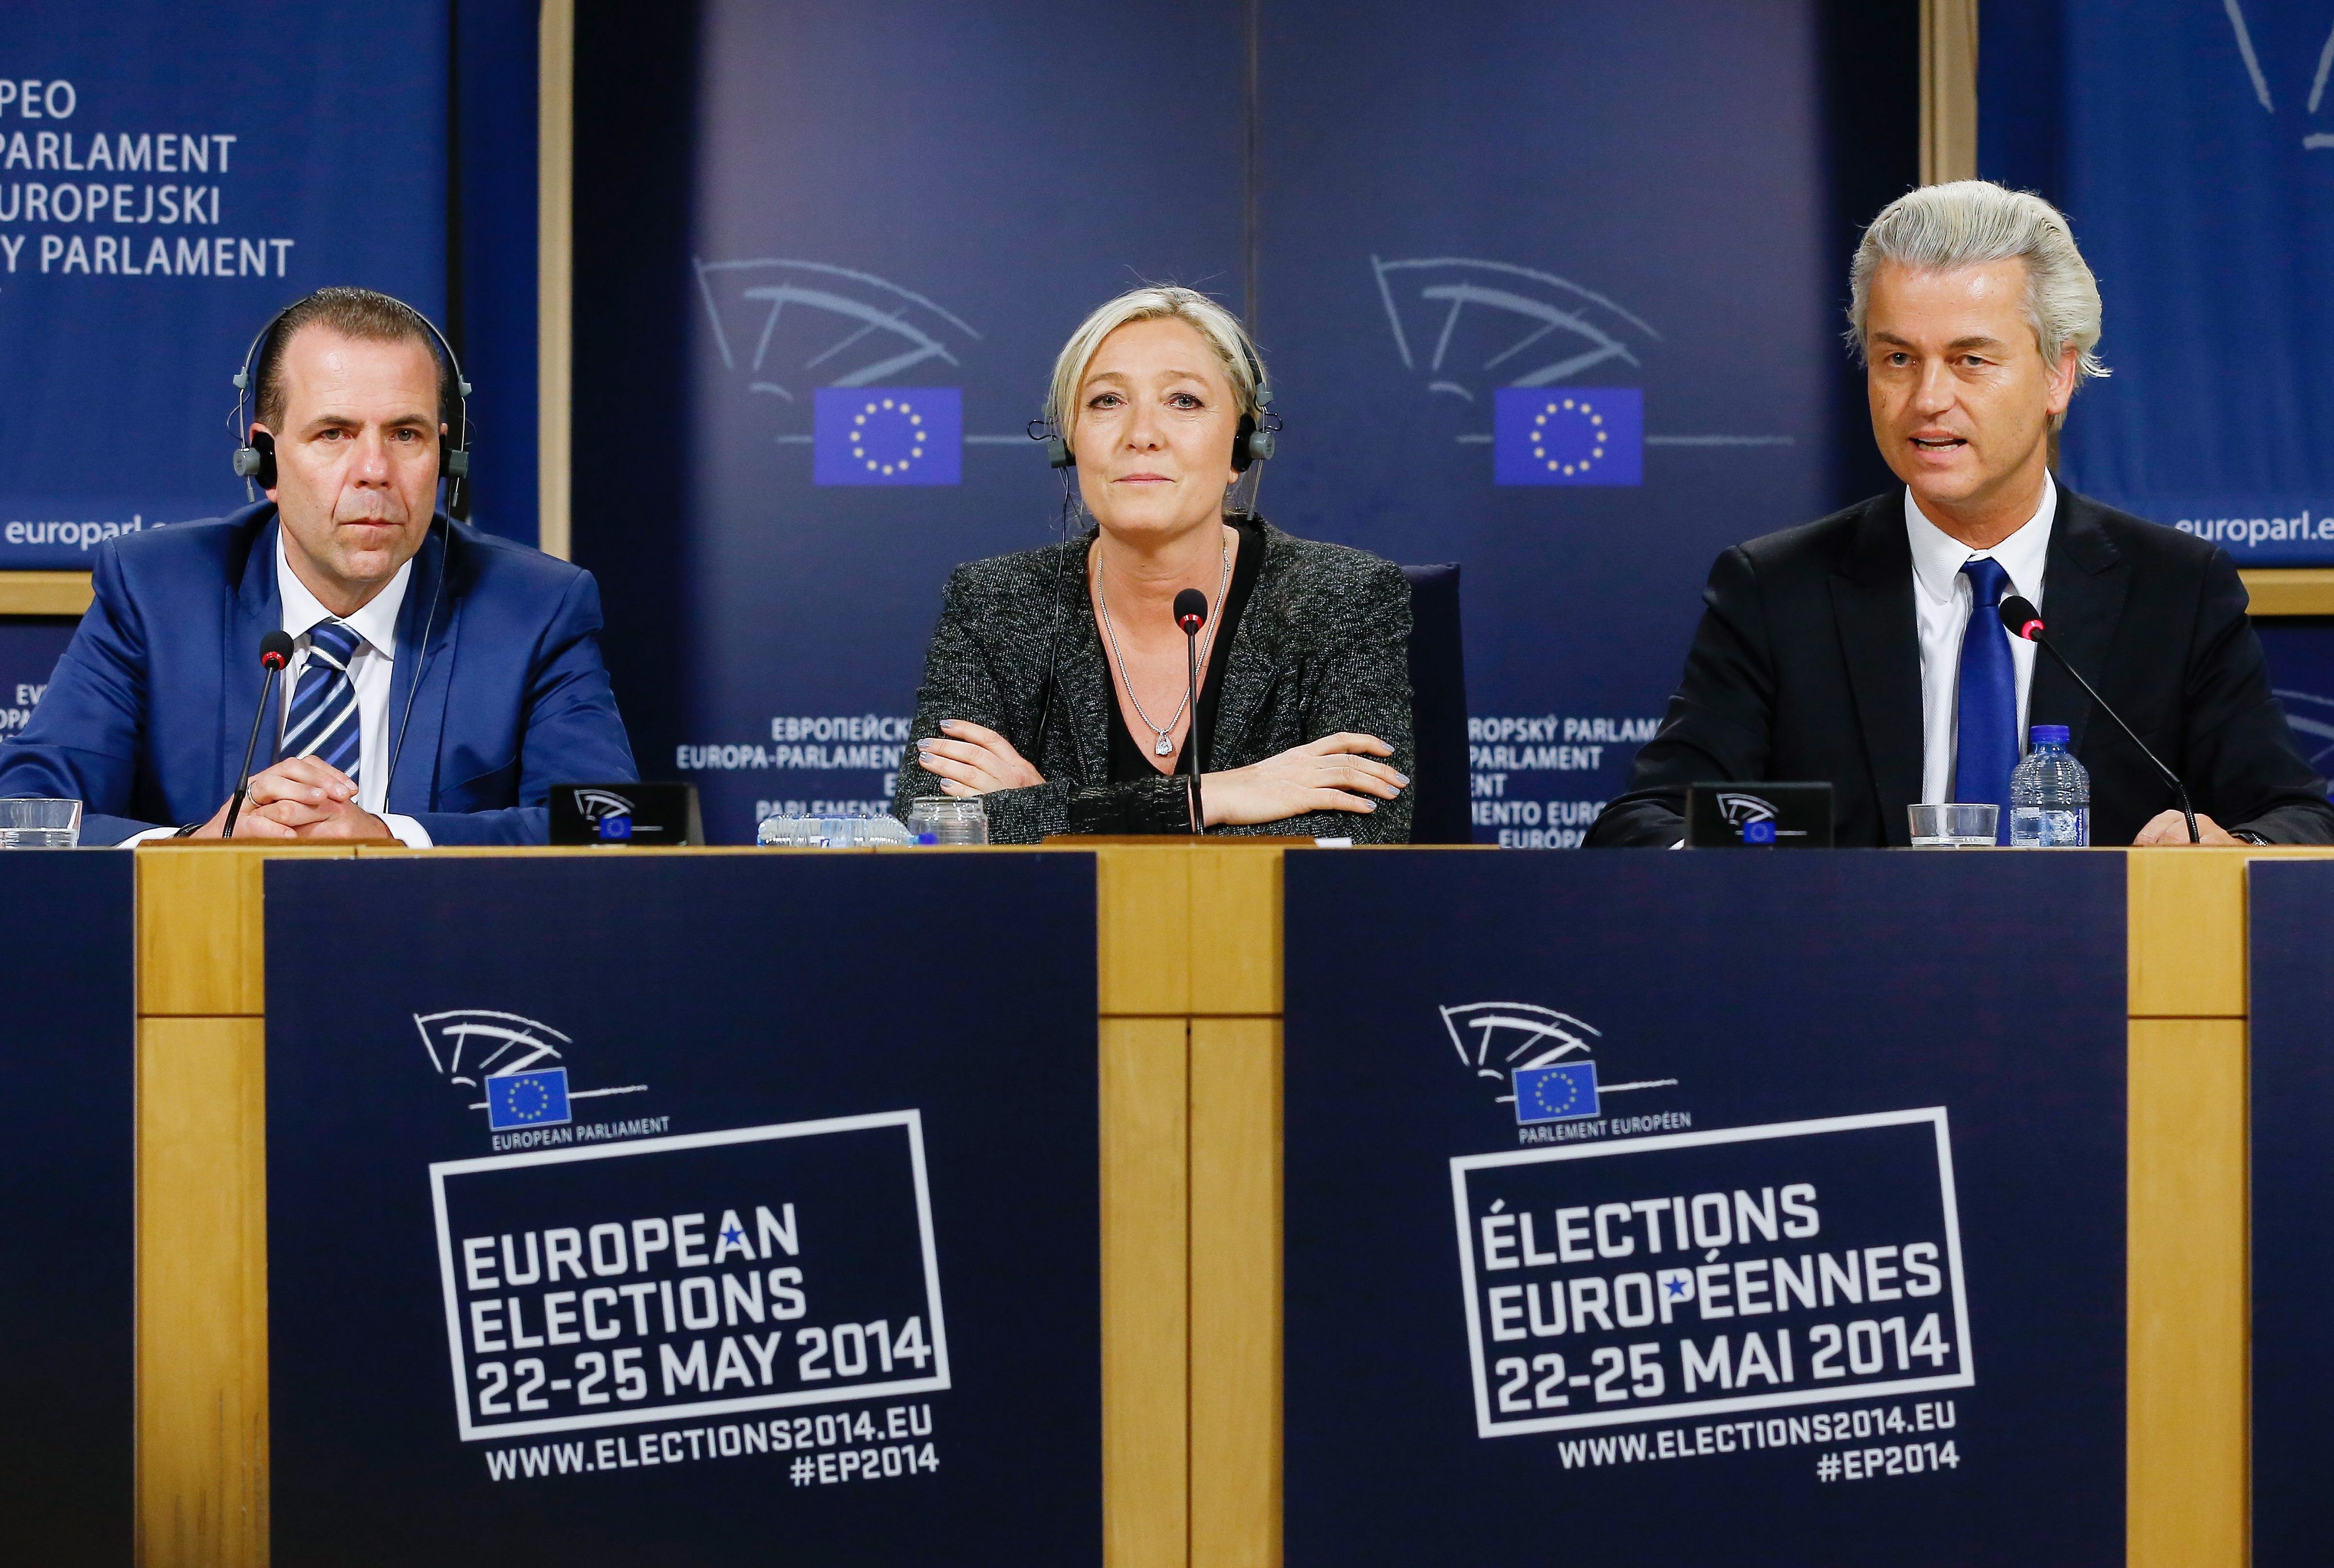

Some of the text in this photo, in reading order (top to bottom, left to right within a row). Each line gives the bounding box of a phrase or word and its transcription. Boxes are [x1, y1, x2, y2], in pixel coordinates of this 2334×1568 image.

[0, 79, 76, 119] PEO
[0, 132, 236, 173] ARLAMENT
[41, 234, 295, 277] PARLAMENT
[1564, 717, 1663, 742] PARLAM
[492, 1116, 670, 1151] EUROPEAN PARLIAMENT
[1519, 1110, 1691, 1144] PARLEMENT EUROPÉEN
[463, 1203, 799, 1291] EUROPEAN
[1481, 1183, 1819, 1270] ÉLECTIONS
[471, 1267, 806, 1353] ELECTIONS
[1489, 1242, 1941, 1342] EUROPÉENNES
[477, 1316, 931, 1415] 22-25 MAY 2014
[1496, 1313, 1950, 1413] 22-25 MAI 2014
[486, 1404, 932, 1481] WWW.ELECTIONS2014.EU
[1558, 1400, 1956, 1469] WWW.ELECTIONS2014.EU
[1817, 1440, 1960, 1483] #EP2014
[790, 1442, 940, 1486] #EP2014
